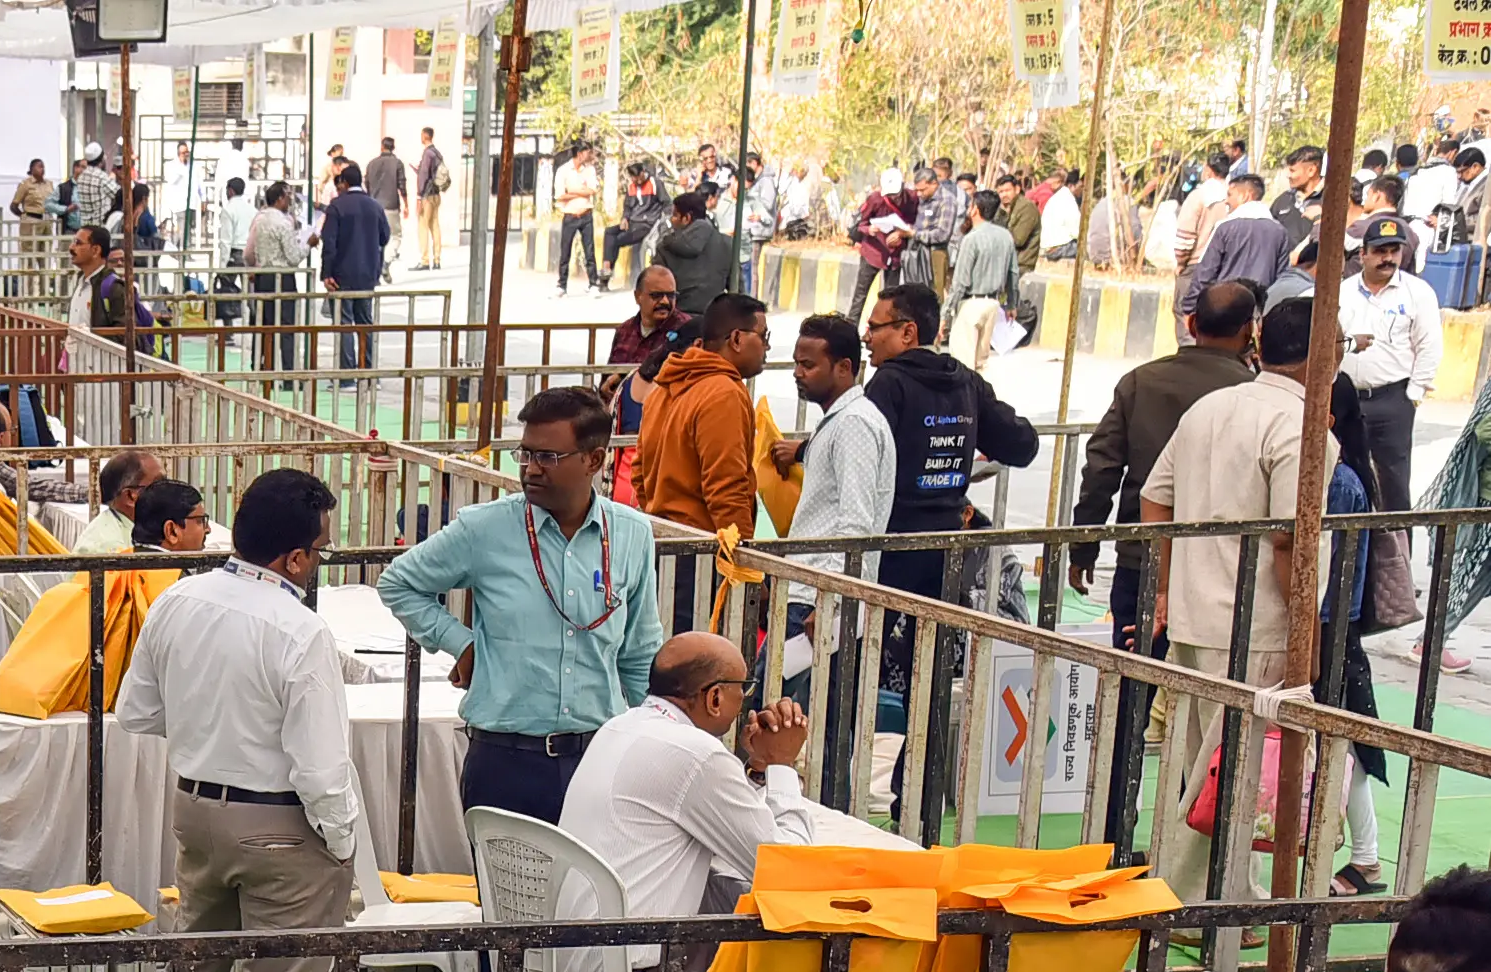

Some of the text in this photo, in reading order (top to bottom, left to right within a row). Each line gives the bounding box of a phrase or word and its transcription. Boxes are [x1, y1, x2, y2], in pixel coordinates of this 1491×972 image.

[930, 435, 965, 448] THINK IT
[925, 457, 963, 470] BUILD IT
[921, 474, 962, 486] TRADE IT
[1066, 663, 1080, 699] आयोग
[1065, 754, 1075, 782] राज्य
